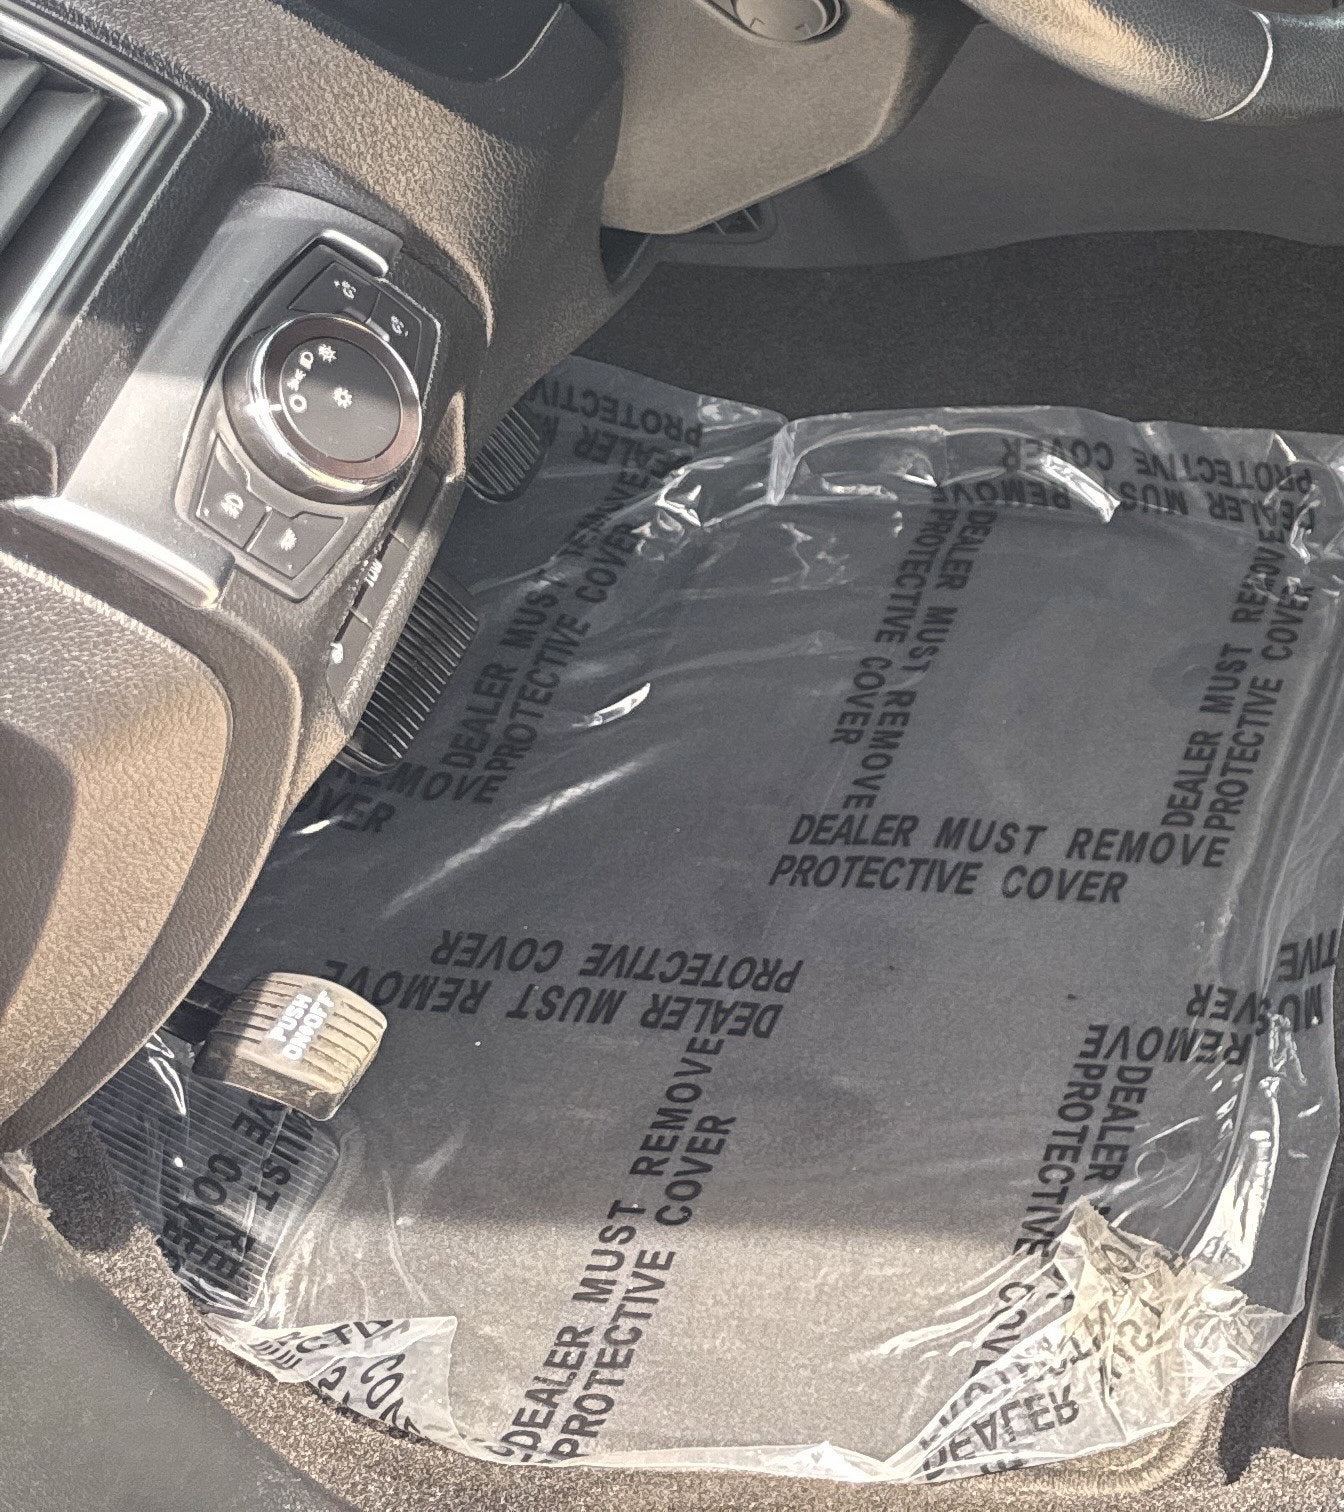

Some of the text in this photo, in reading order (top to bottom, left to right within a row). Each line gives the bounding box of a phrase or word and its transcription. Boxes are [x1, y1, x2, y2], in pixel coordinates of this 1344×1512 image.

[525, 378, 704, 448] PROTECTIV
[1118, 480, 1190, 516] MUS
[1131, 446, 1312, 494] PROTECTIVE
[487, 522, 637, 771] PROTECTIVE COVER
[831, 507, 959, 746] PROTECTIVE COVER
[843, 509, 998, 810] DEALER MUST REMOVE
[442, 662, 518, 770] DEALER
[1161, 729, 1223, 828] DEALER
[1199, 642, 1253, 715] MUST
[1203, 675, 1285, 832] PROTECTIVE
[770, 855, 1129, 905] PROTECTIVE COVER
[789, 813, 1230, 869] DEALER MUST REMOVE
[321, 958, 783, 1039] DEALER MUST REMOVE
[430, 929, 802, 994] PROTECTIVE COVER
[270, 992, 314, 1042] PUSH
[1079, 1023, 1254, 1067] REMOVE
[1013, 1061, 1107, 1259] PROTECTIVE
[1082, 1062, 1152, 1181] DEALER
[500, 1036, 726, 1464] DEALER MUST REMOVE
[550, 1115, 736, 1463] PROTECTIVE COVER
